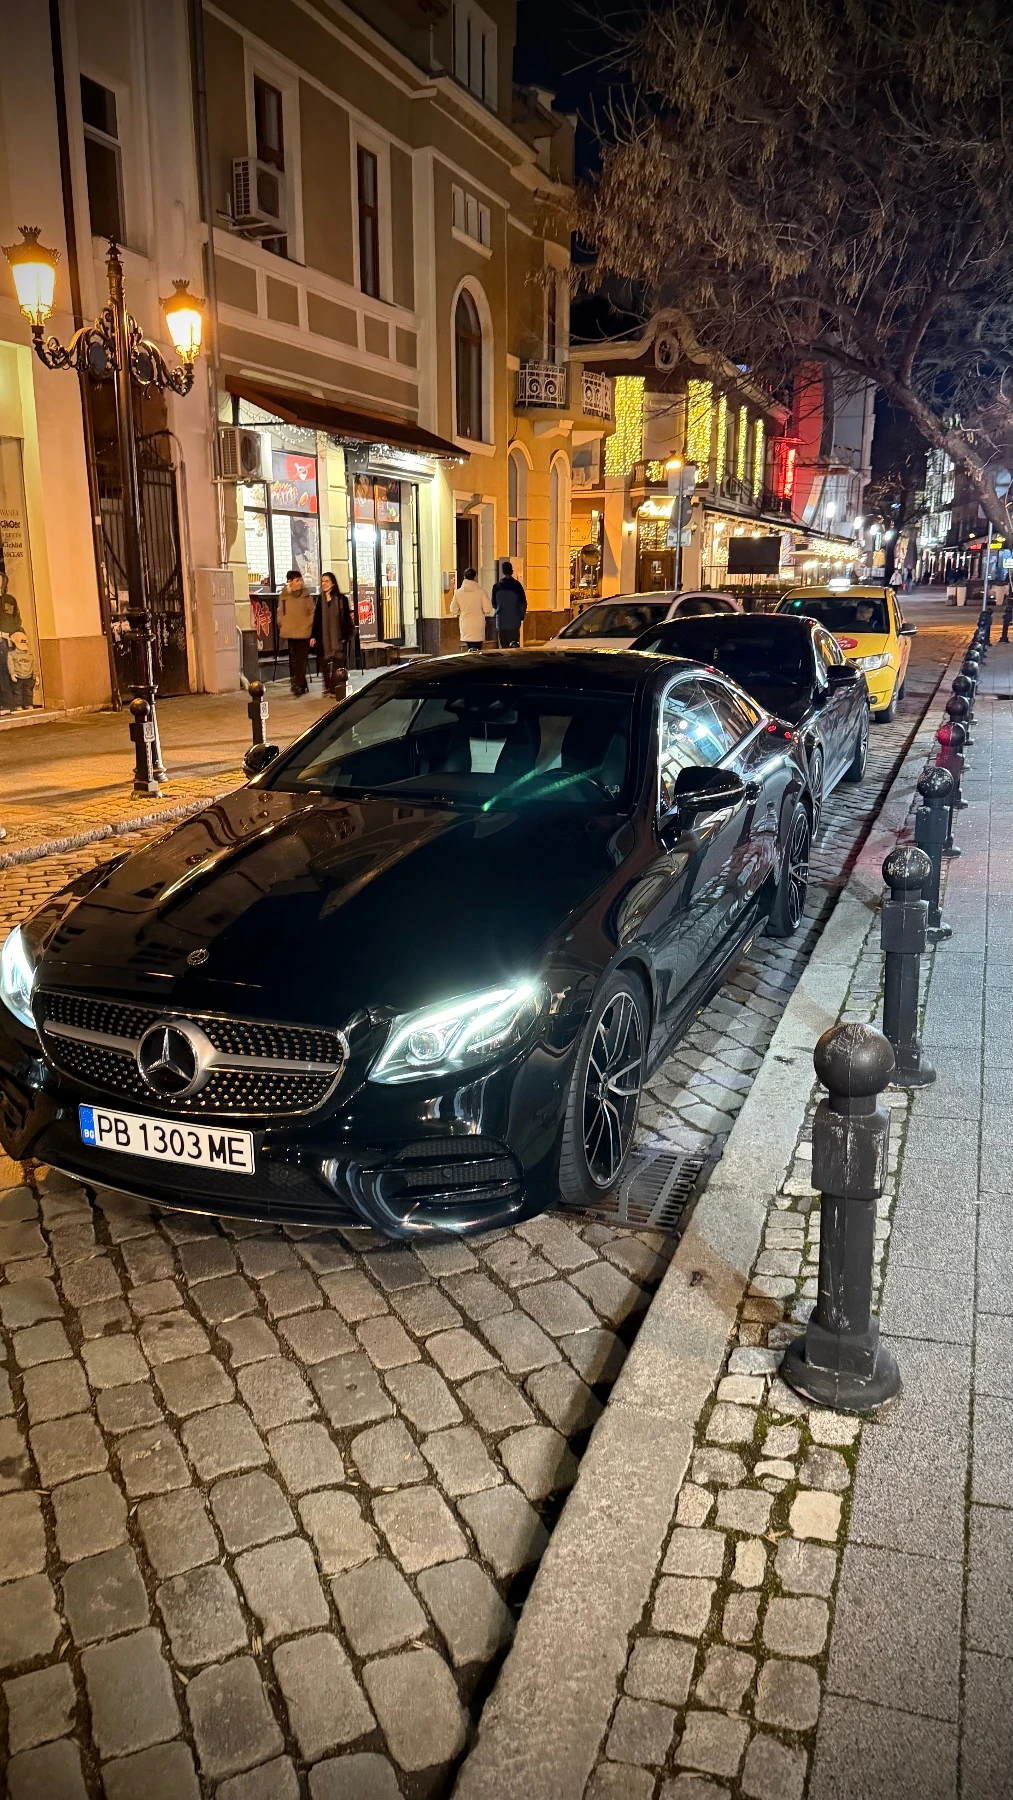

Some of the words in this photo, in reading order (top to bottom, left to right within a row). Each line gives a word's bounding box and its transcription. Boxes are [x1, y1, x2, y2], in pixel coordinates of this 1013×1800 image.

[84, 1128, 95, 1140] BG
[97, 1114, 131, 1147] PB
[139, 1123, 202, 1160] 1303
[208, 1134, 247, 1167] ME
